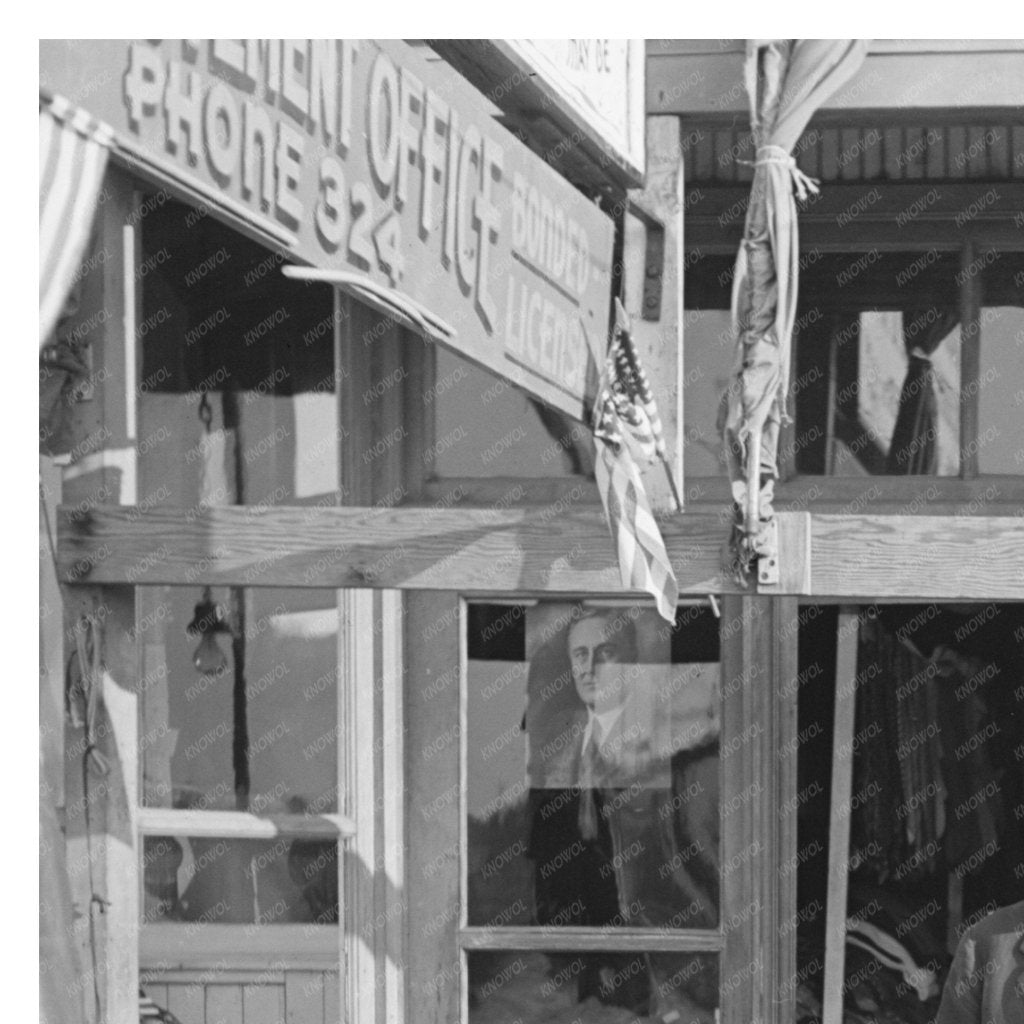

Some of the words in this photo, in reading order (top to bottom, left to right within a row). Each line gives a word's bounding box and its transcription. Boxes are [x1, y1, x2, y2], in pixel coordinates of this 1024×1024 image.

[314, 155, 402, 287] 324
[365, 52, 503, 337] OFFICE
[511, 172, 588, 295] BONDED
